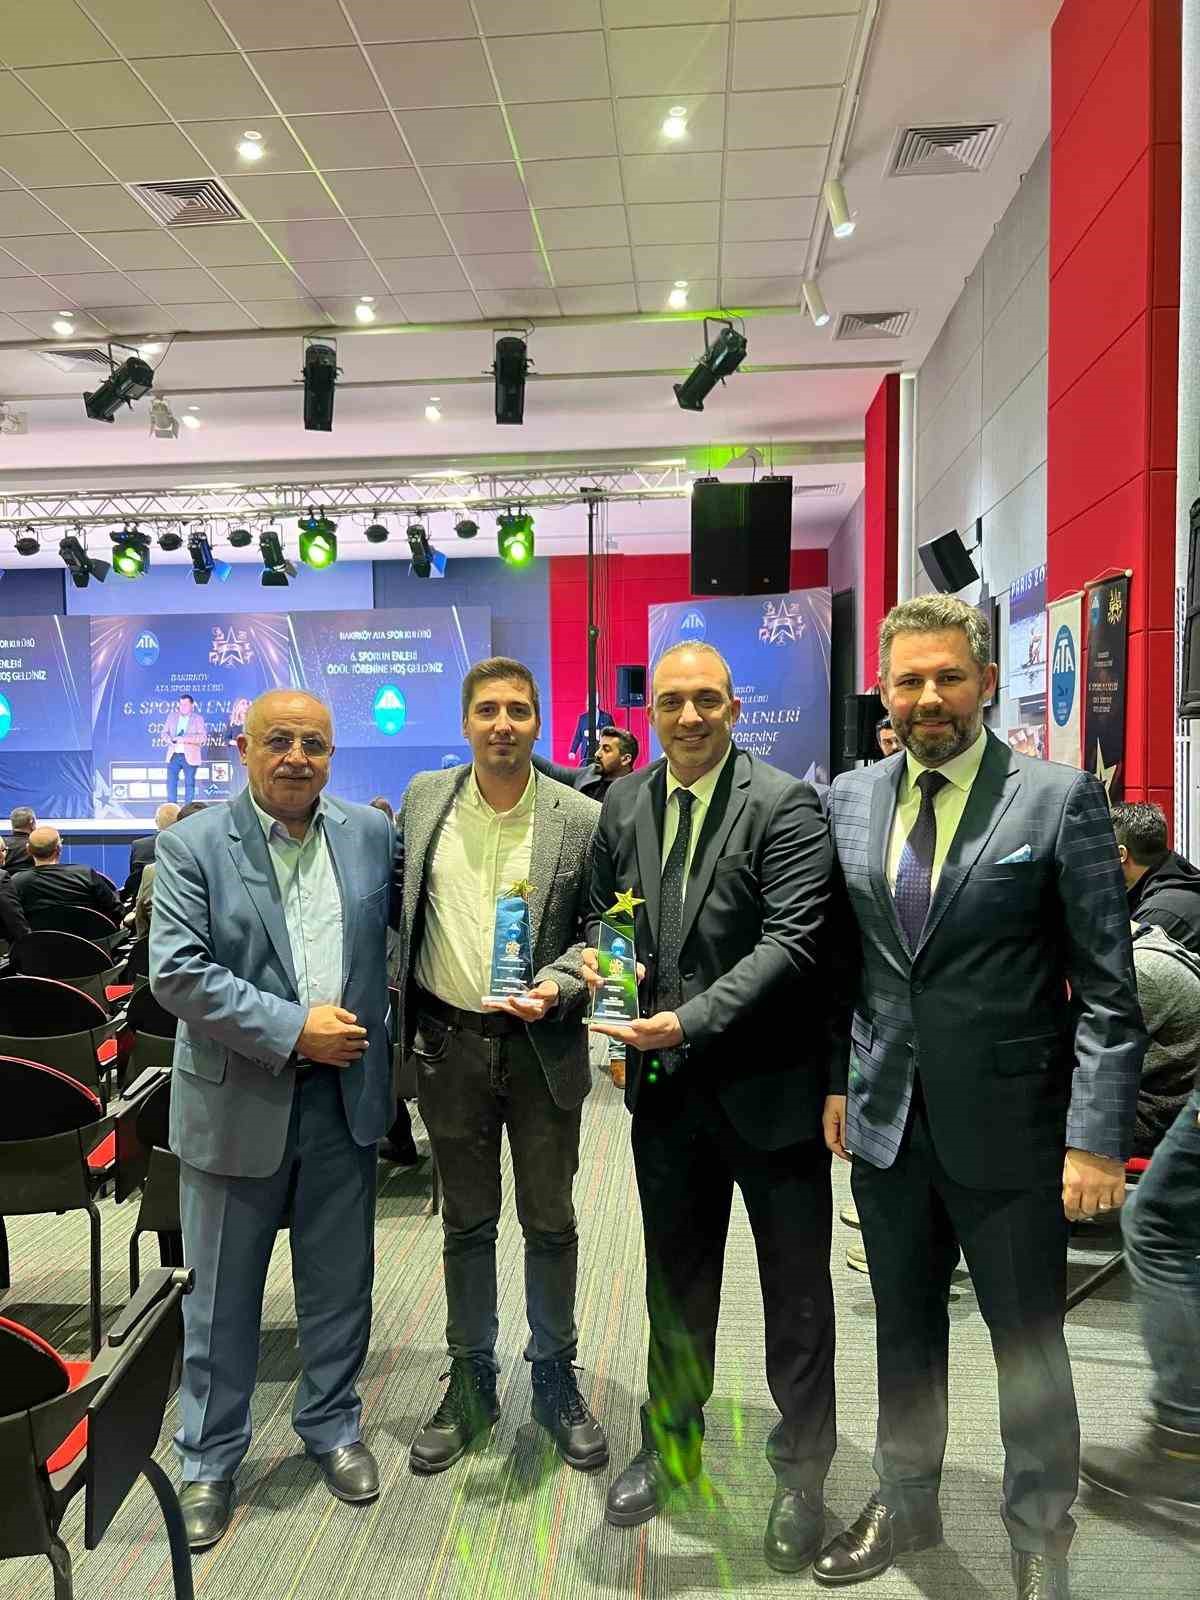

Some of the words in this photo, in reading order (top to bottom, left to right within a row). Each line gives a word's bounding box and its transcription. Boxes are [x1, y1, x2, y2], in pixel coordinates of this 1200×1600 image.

[1010, 573, 1032, 598] PARIS
[681, 614, 705, 629] ATA
[136, 634, 159, 649] ATA
[1053, 638, 1075, 673] ATA
[123, 702, 136, 715] 6.
[139, 700, 202, 715] SPORN
[752, 706, 801, 724] ENLERİ
